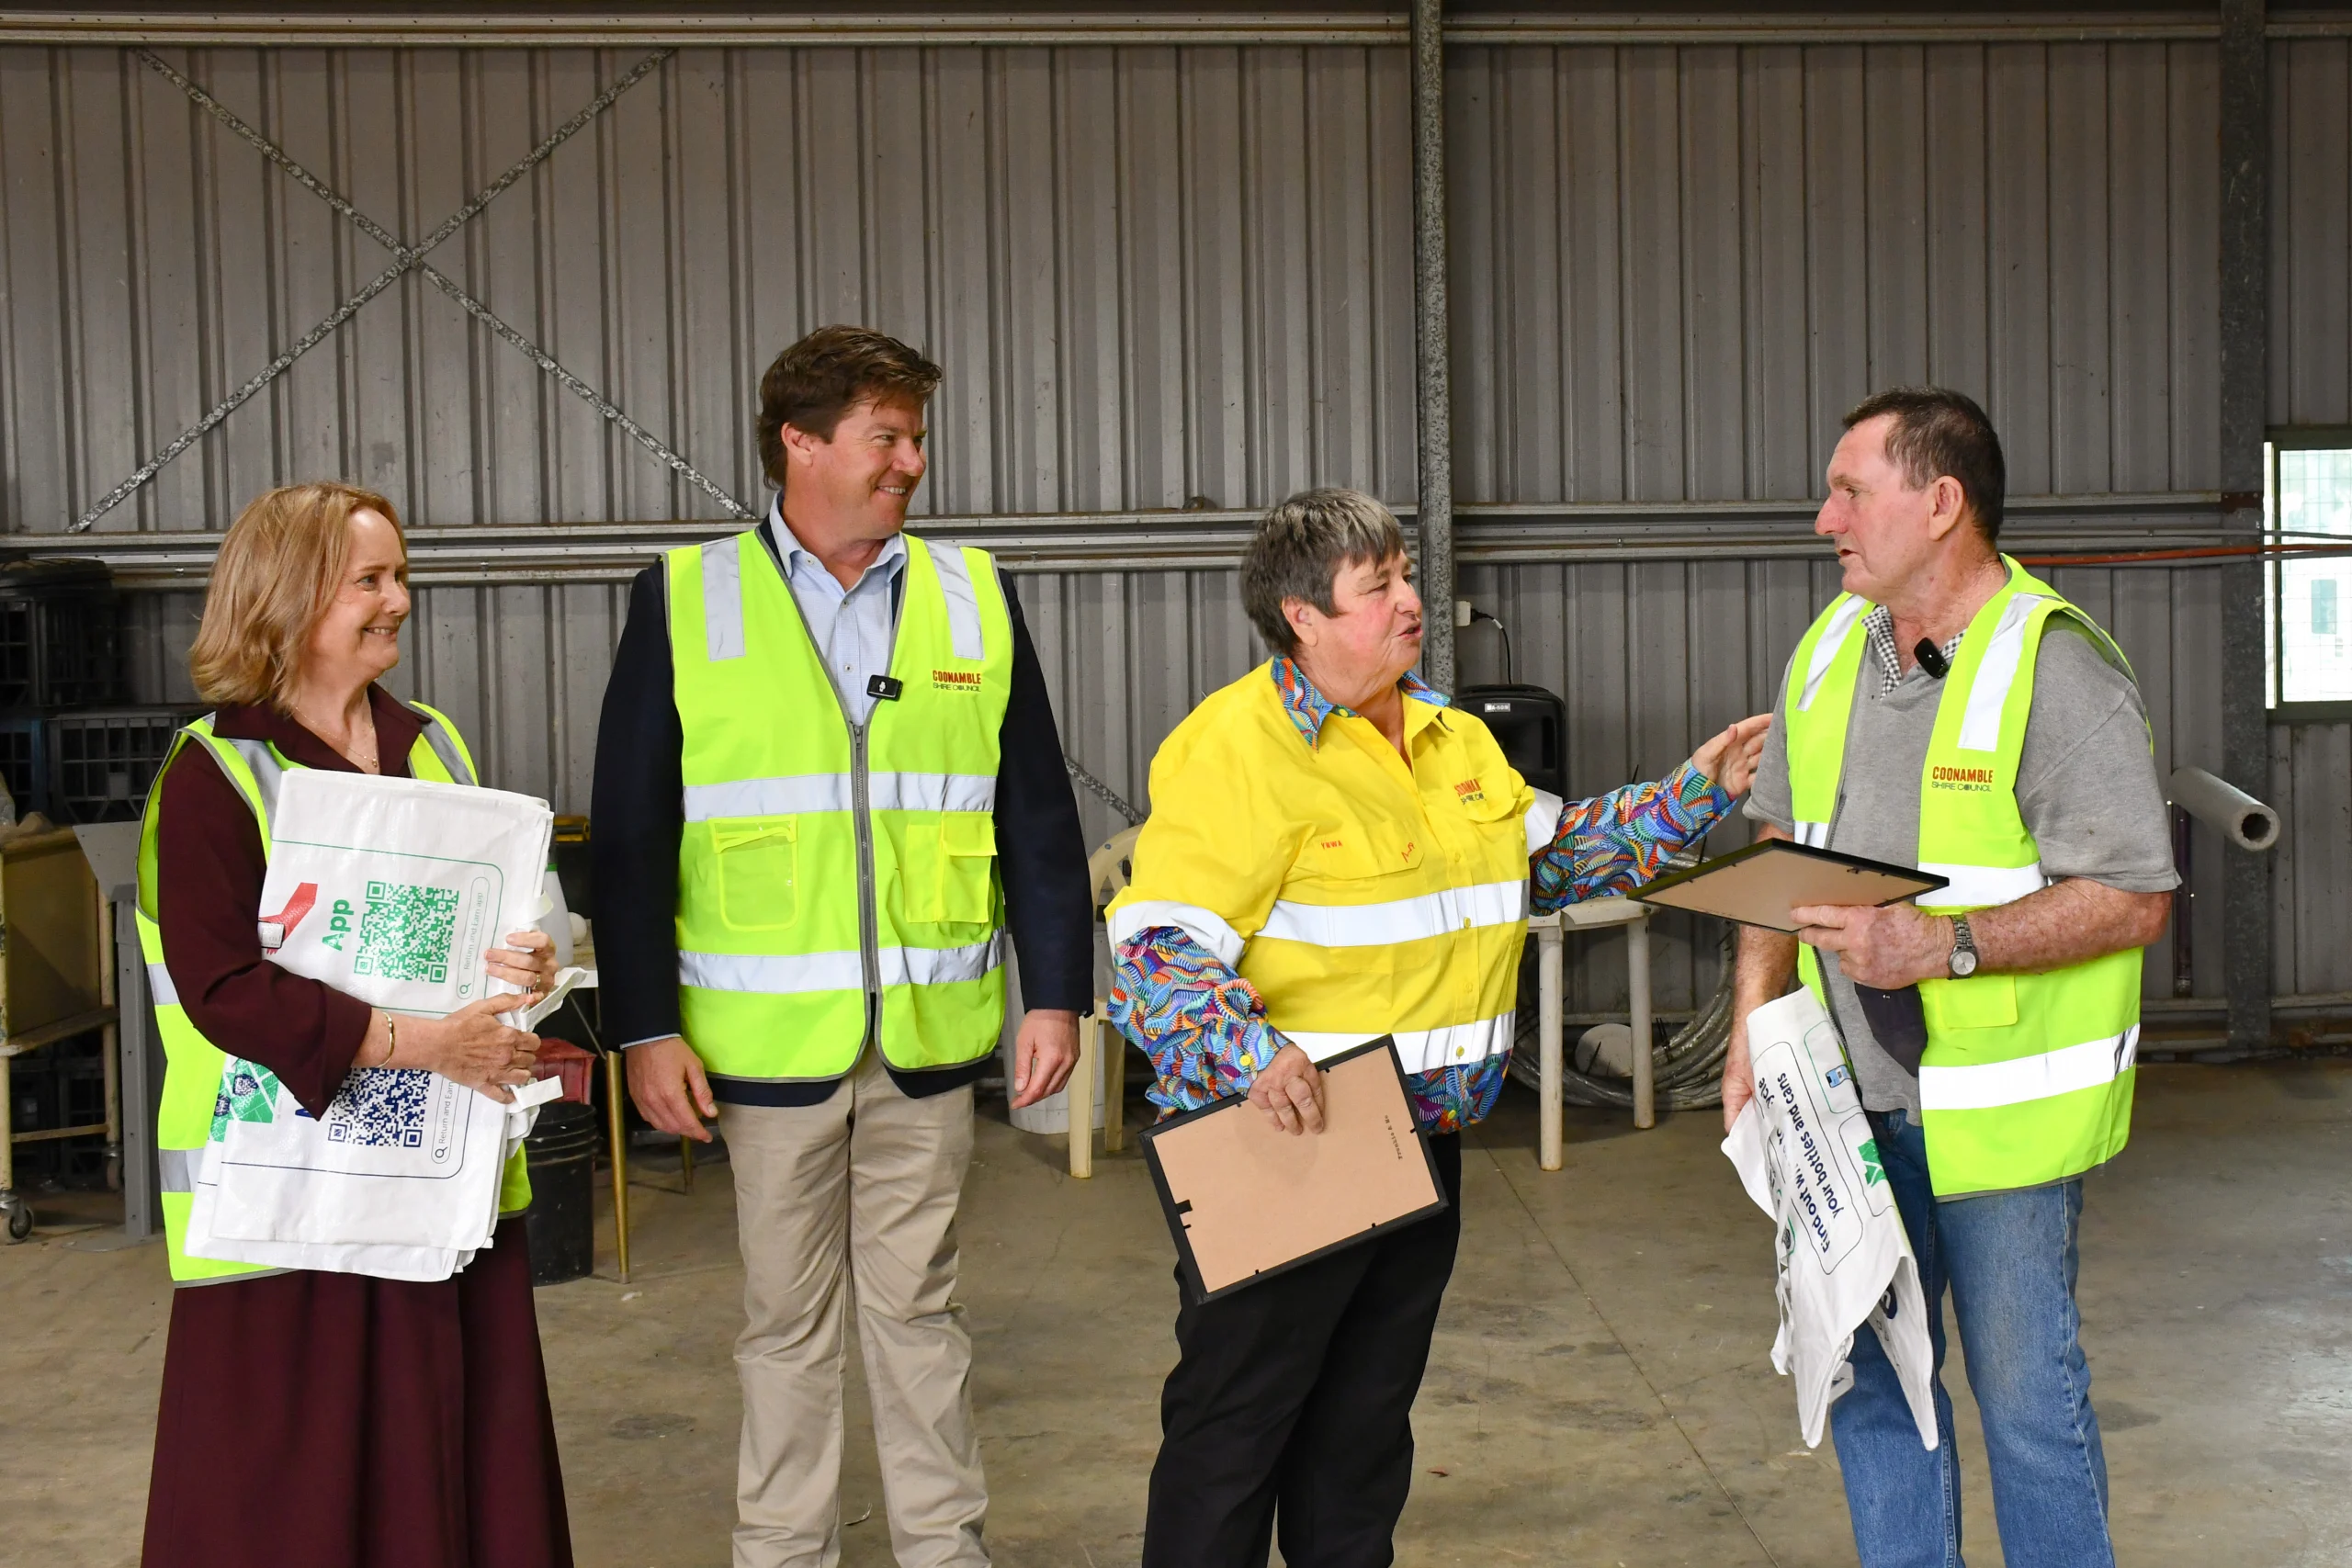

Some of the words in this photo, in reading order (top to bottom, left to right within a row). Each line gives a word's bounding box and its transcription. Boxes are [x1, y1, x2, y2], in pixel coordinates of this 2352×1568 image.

[933, 670, 981, 684] COONAMBLE
[933, 682, 951, 691] SHIRE
[1931, 781, 1956, 790] SHIRE
[1957, 784, 1992, 792] COUNCIL
[1932, 766, 1994, 783] COONAMBLE
[322, 899, 355, 952] App
[464, 946, 474, 970] Return
[471, 908, 481, 927] Earn
[445, 1081, 454, 1100] Earn
[1758, 1077, 1775, 1110] ycle
[1777, 1072, 1794, 1105] cans
[443, 1101, 451, 1116] and
[1787, 1103, 1804, 1132] and
[438, 1118, 448, 1144] Return
[1801, 1131, 1828, 1187] bottles
[1799, 1187, 1817, 1215] out
[1821, 1184, 1845, 1219] your
[1811, 1213, 1831, 1253] Find
